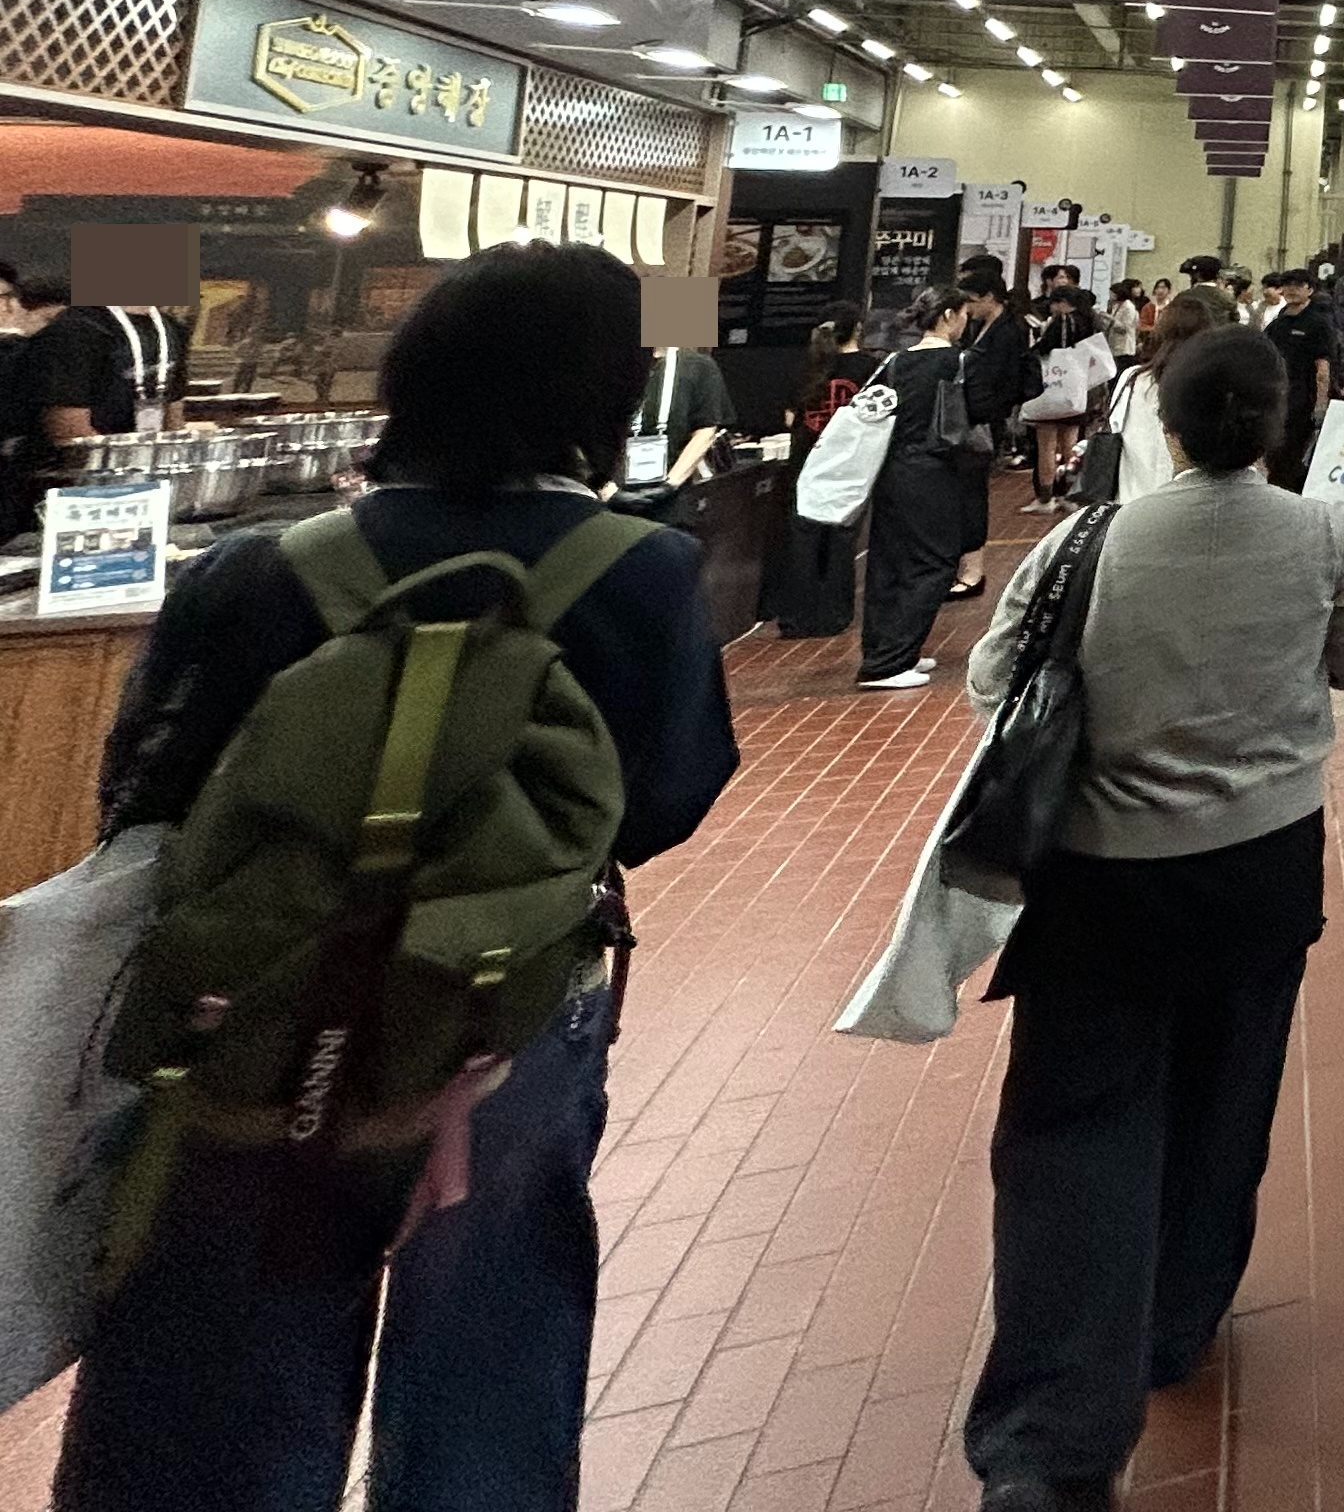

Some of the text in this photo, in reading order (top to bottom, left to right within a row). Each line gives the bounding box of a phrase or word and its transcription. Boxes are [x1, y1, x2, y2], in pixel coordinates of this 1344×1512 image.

[763, 125, 814, 142] 1A-1
[900, 166, 939, 179] 1A-2
[978, 190, 1009, 201] 1A-3
